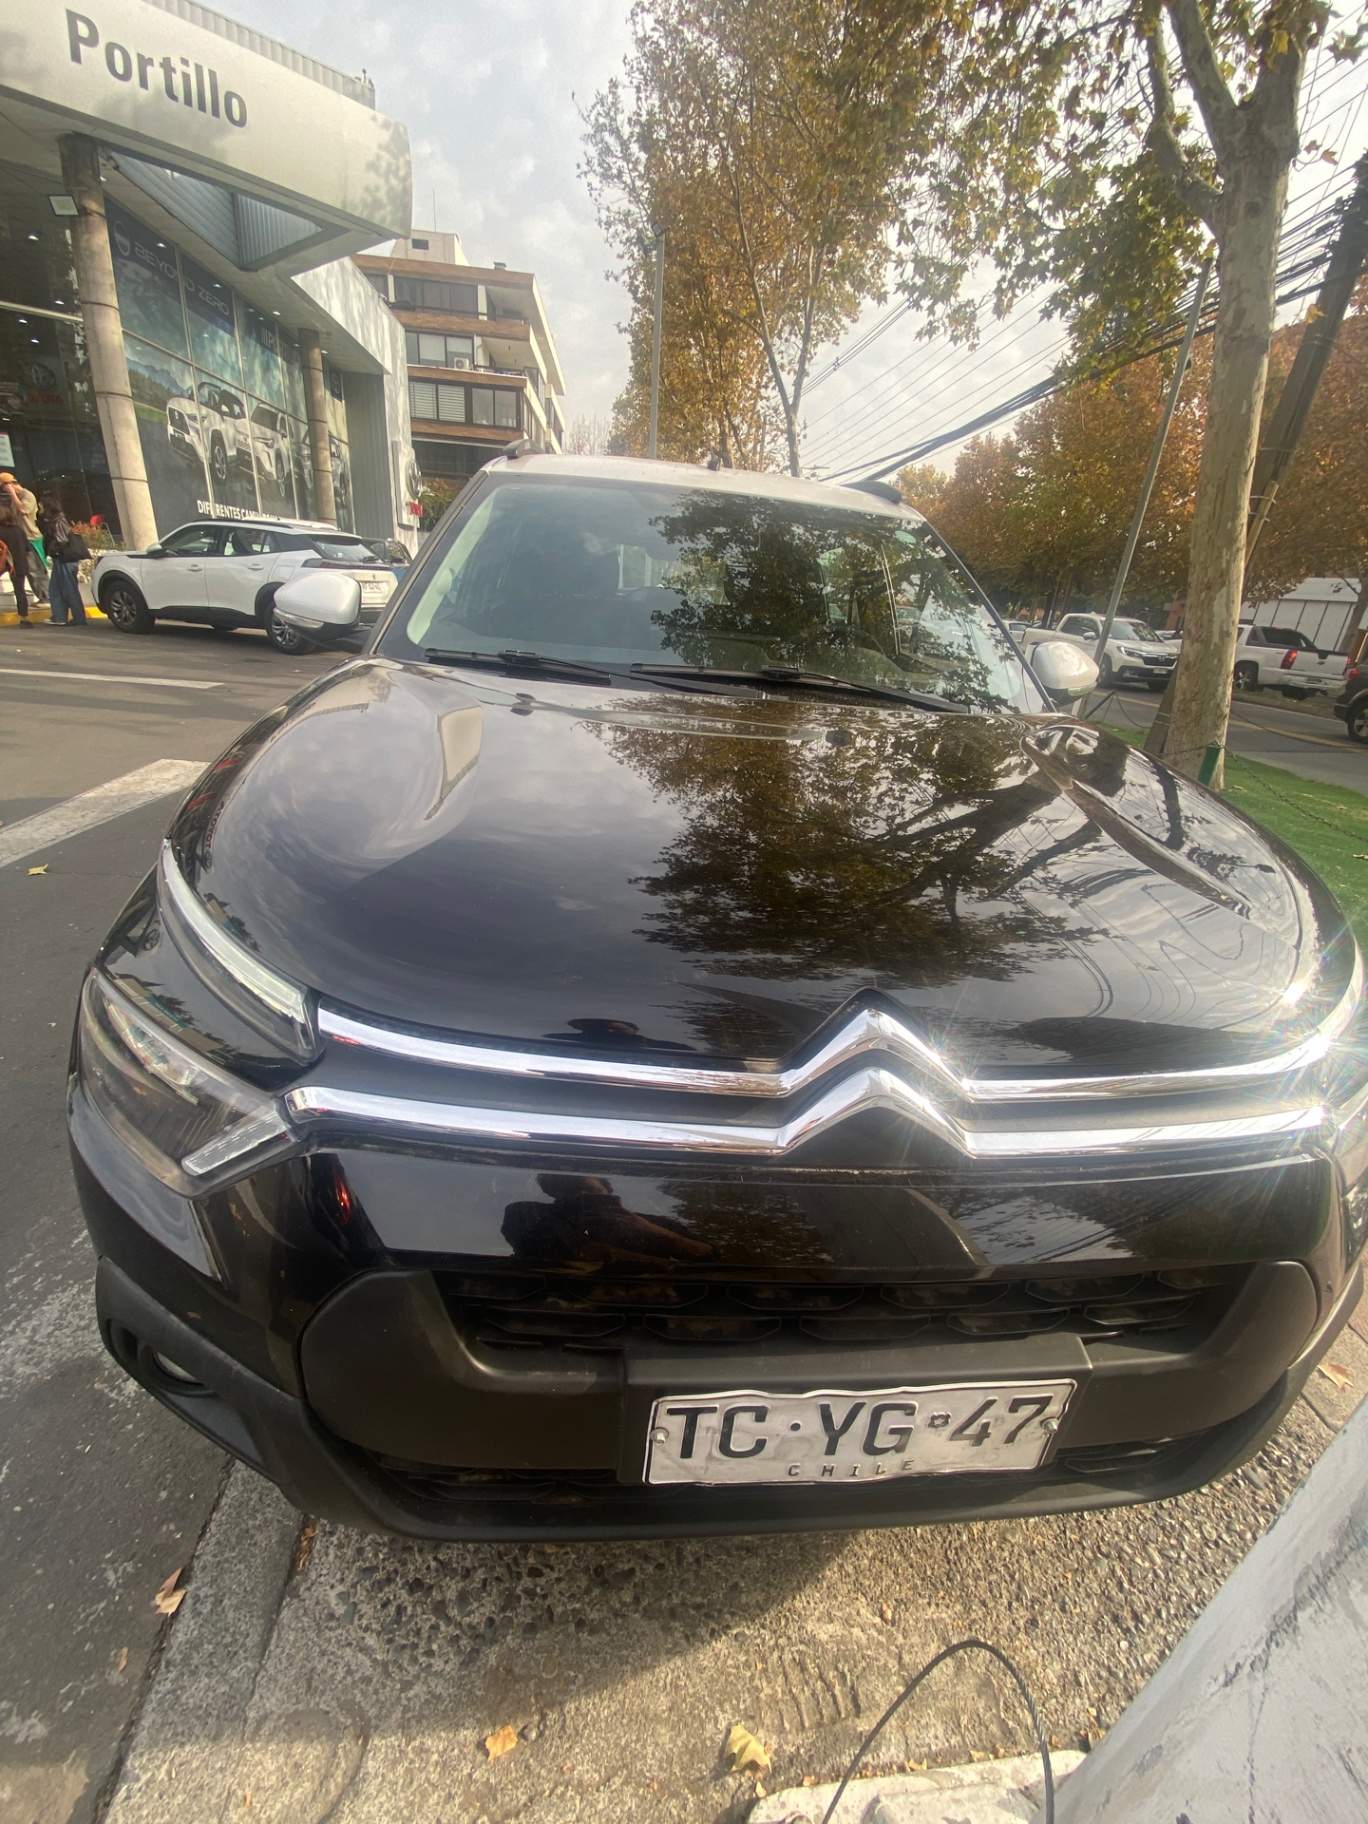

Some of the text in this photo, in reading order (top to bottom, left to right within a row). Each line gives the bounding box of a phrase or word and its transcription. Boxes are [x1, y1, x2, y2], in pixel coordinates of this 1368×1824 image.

[66, 9, 248, 128] Portillo
[135, 241, 195, 291] BEYOD
[197, 500, 240, 519] DIFRENTES
[787, 1458, 914, 1477] CHILE
